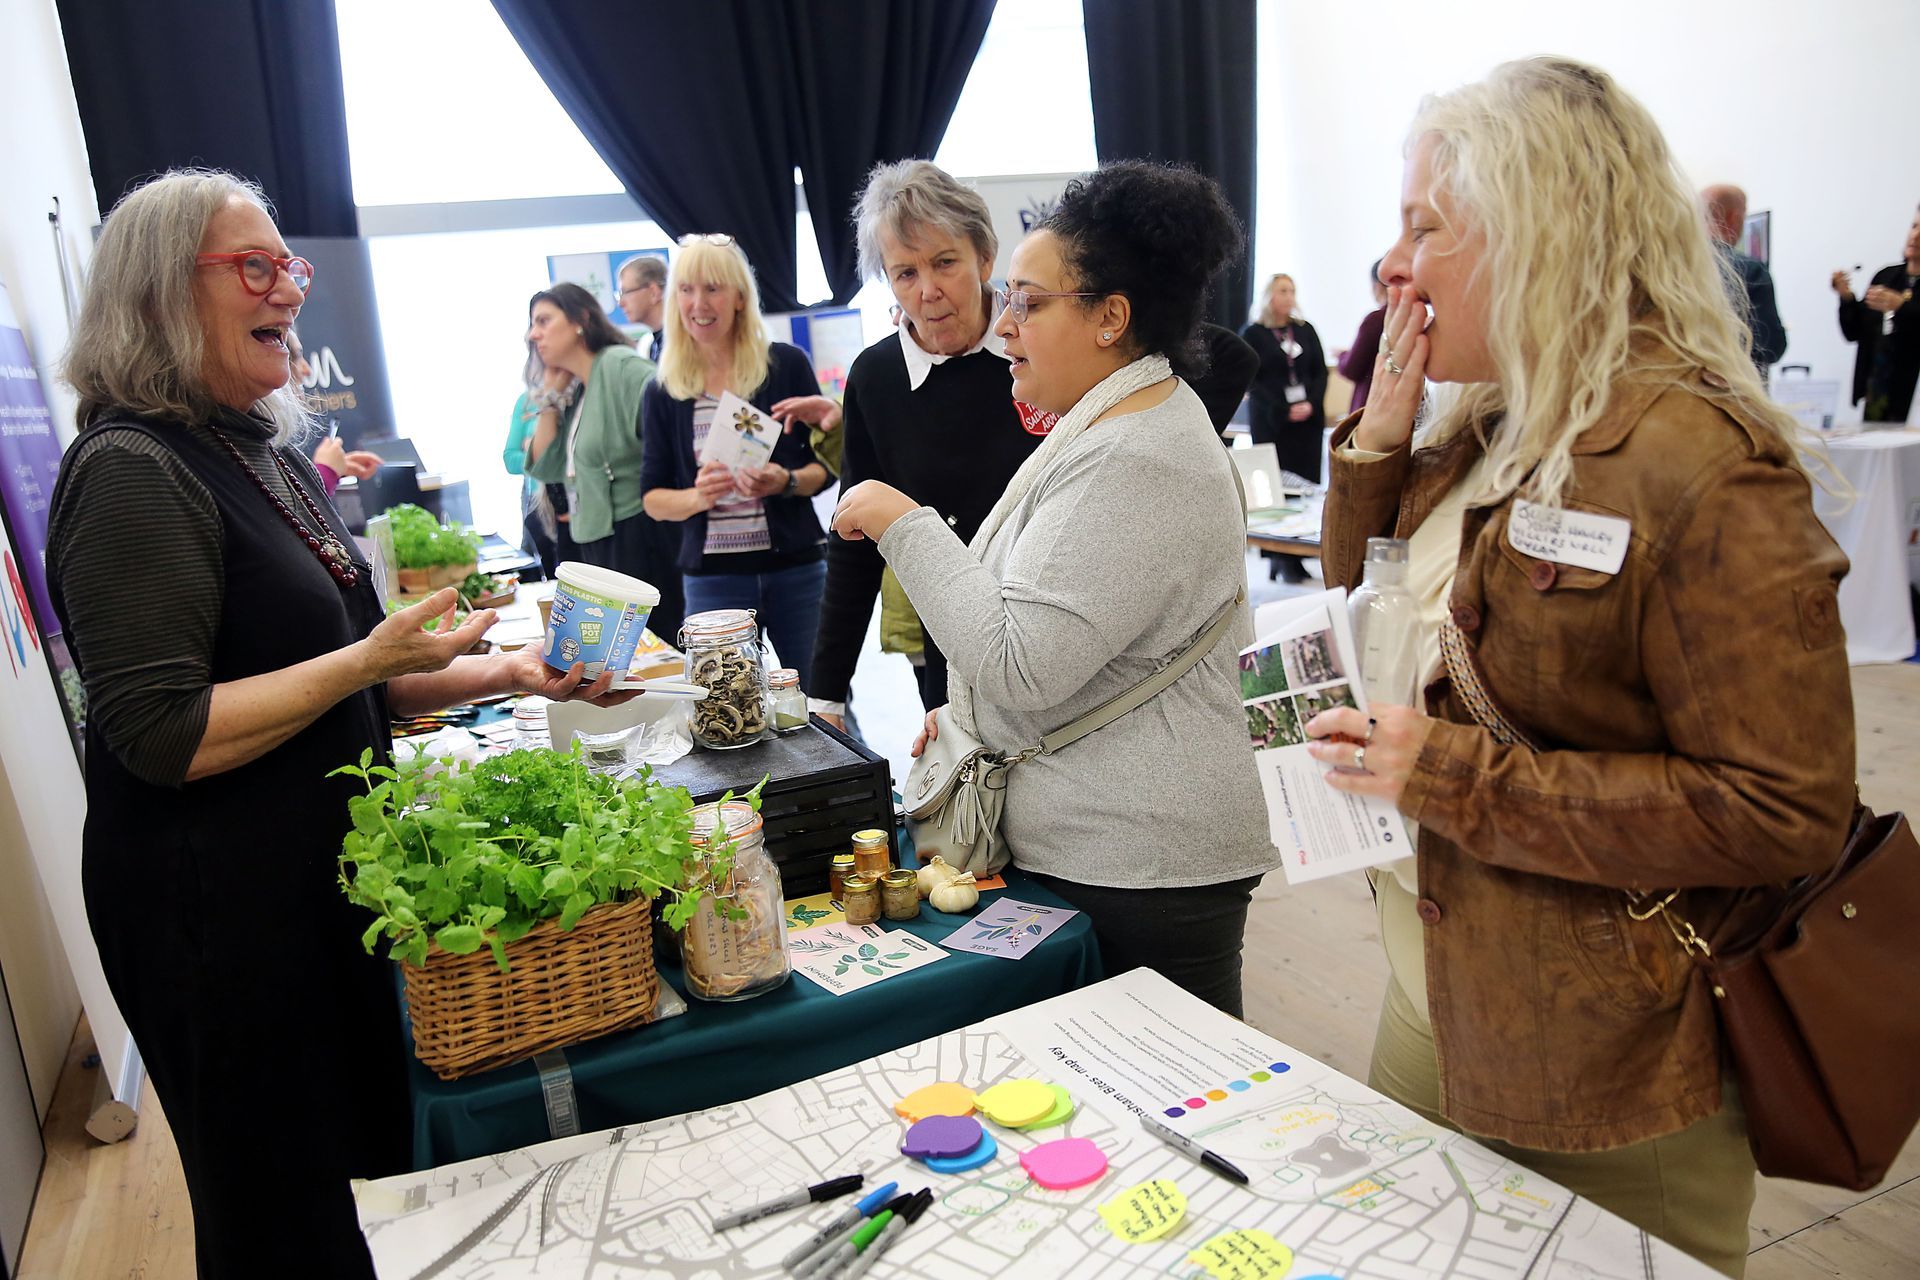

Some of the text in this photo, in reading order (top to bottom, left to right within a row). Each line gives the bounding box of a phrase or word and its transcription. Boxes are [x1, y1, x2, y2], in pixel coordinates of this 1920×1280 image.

[1025, 410, 1048, 430] SALVA
[1042, 412, 1060, 431] ARM
[573, 590, 602, 604] PLASTIC
[580, 622, 601, 630] NEW
[581, 629, 600, 637] POT
[970, 944, 999, 952] SAGE
[804, 965, 845, 989] PEPPERMINT
[1048, 1045, 1068, 1061] key
[1065, 1058, 1088, 1075] map
[1089, 1075, 1116, 1095] Bites
[1112, 1092, 1150, 1118] nsham
